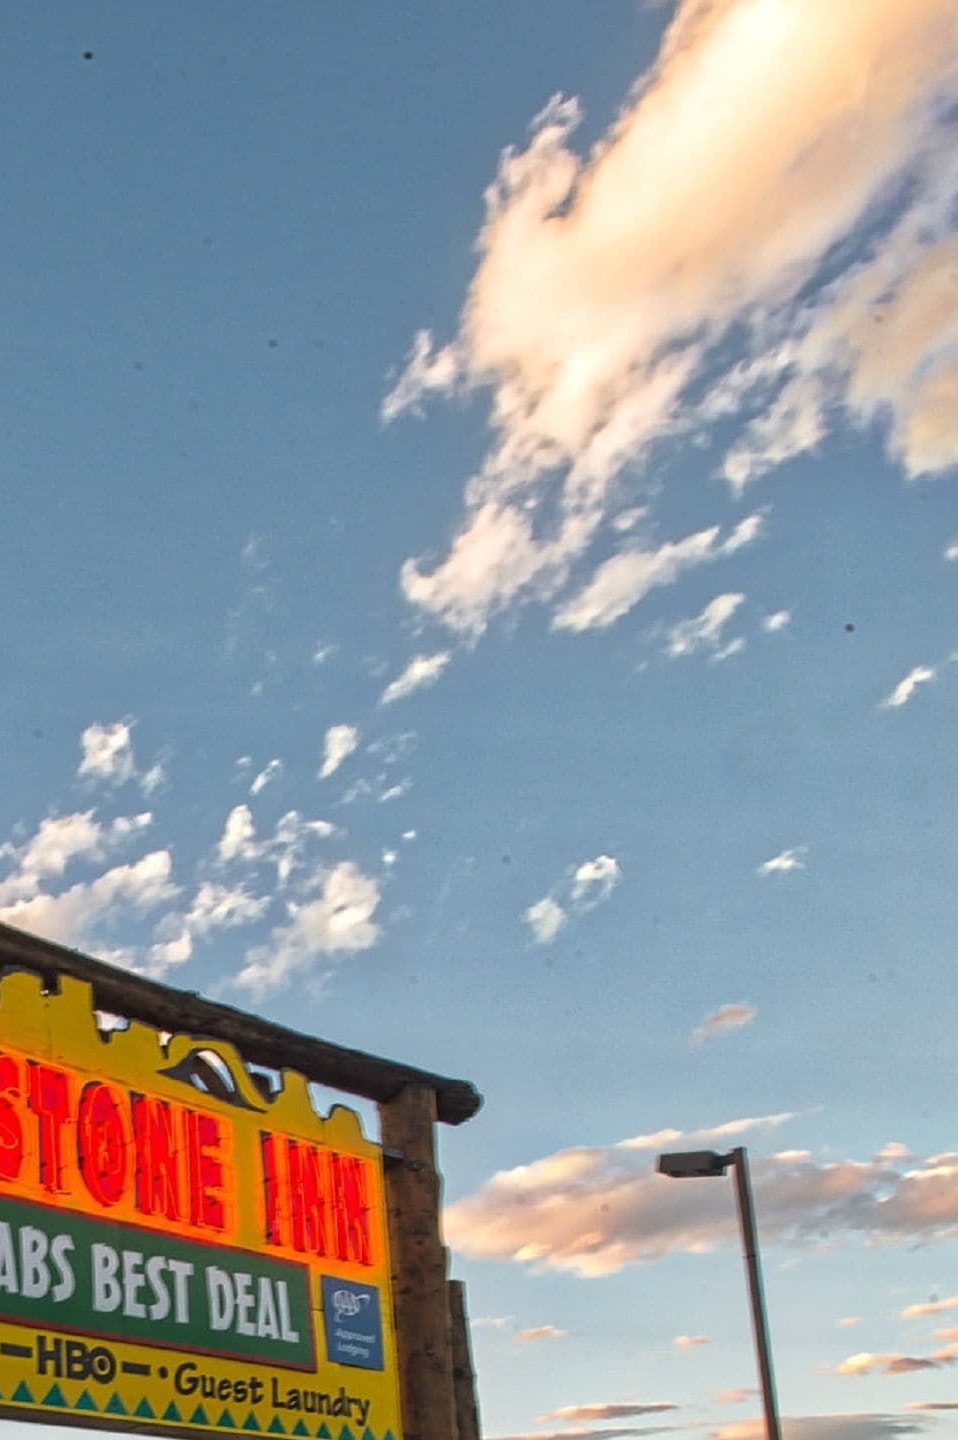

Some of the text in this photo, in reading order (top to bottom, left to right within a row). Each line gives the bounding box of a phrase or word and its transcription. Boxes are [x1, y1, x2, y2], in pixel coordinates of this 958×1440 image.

[260, 1128, 374, 1267] INN
[91, 1242, 195, 1324] BEST
[205, 1265, 300, 1344] DEAL
[35, 1335, 117, 1384] HBO
[174, 1362, 264, 1405] Guest
[271, 1376, 371, 1427] Laundry
